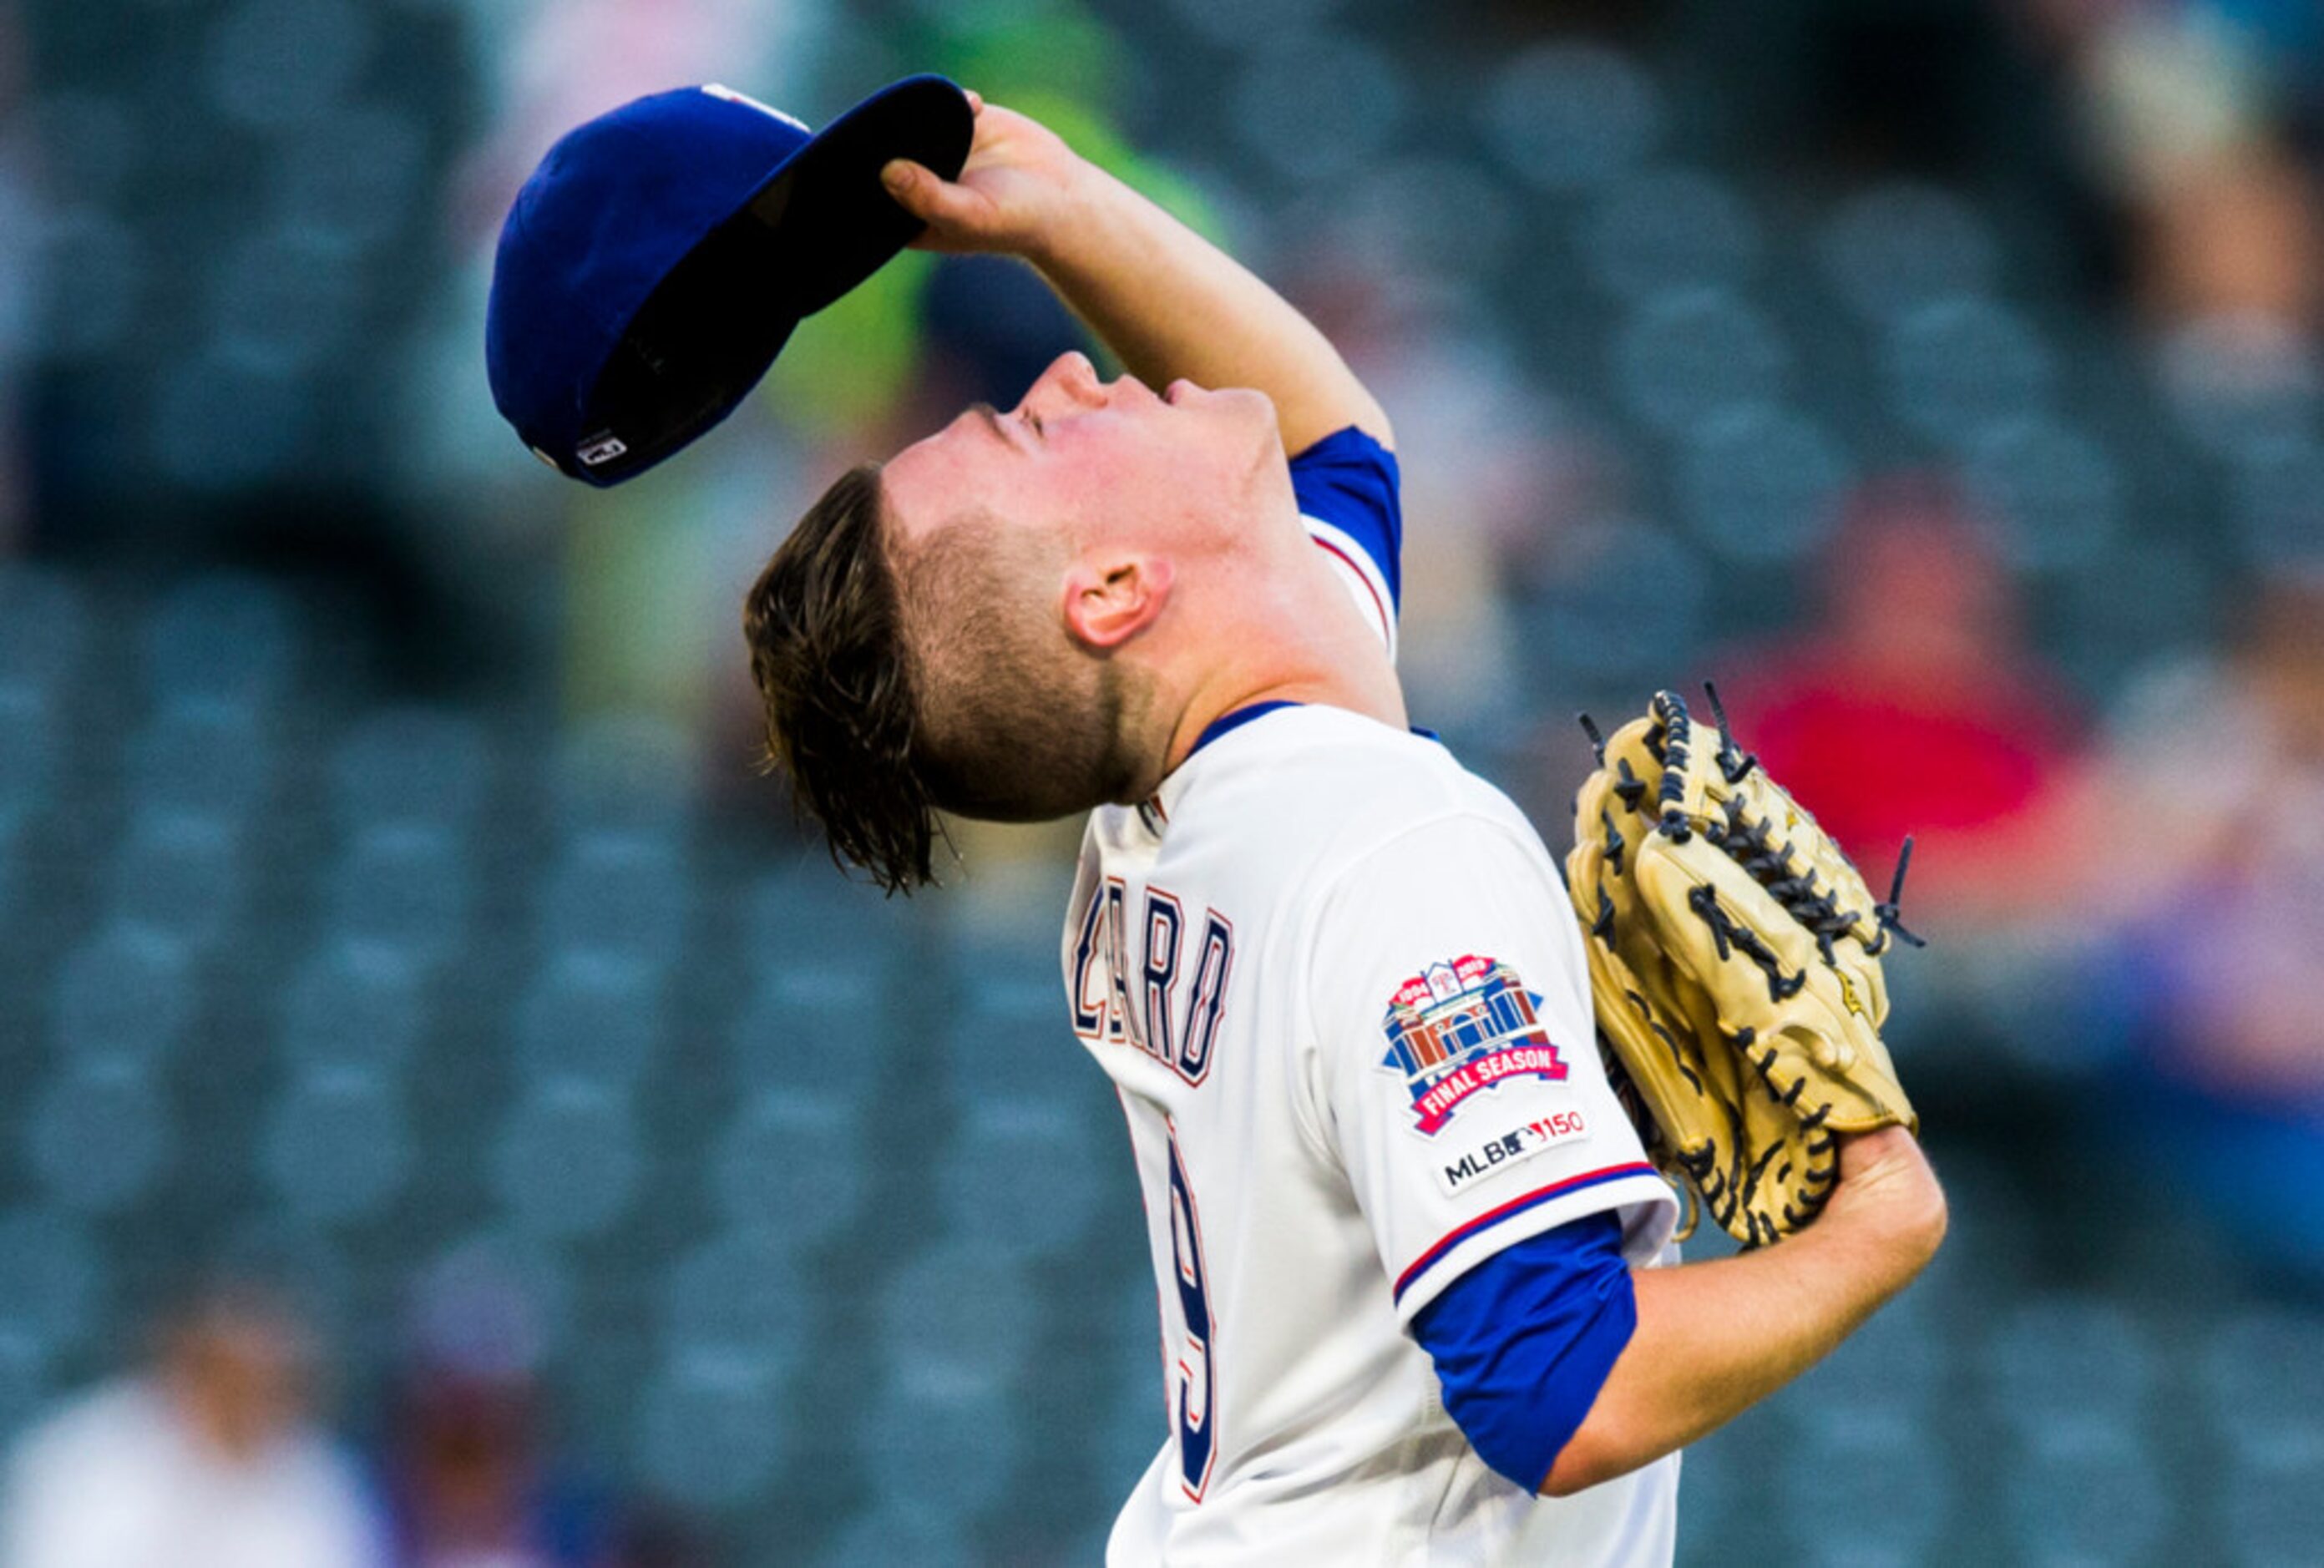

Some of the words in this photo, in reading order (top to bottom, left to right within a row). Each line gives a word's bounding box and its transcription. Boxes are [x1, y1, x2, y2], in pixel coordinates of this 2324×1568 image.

[1422, 1071, 1477, 1117] FINAL
[1476, 1050, 1552, 1082] SEASON
[1445, 1143, 1505, 1186] MLB
[1543, 1111, 1584, 1141] 150
